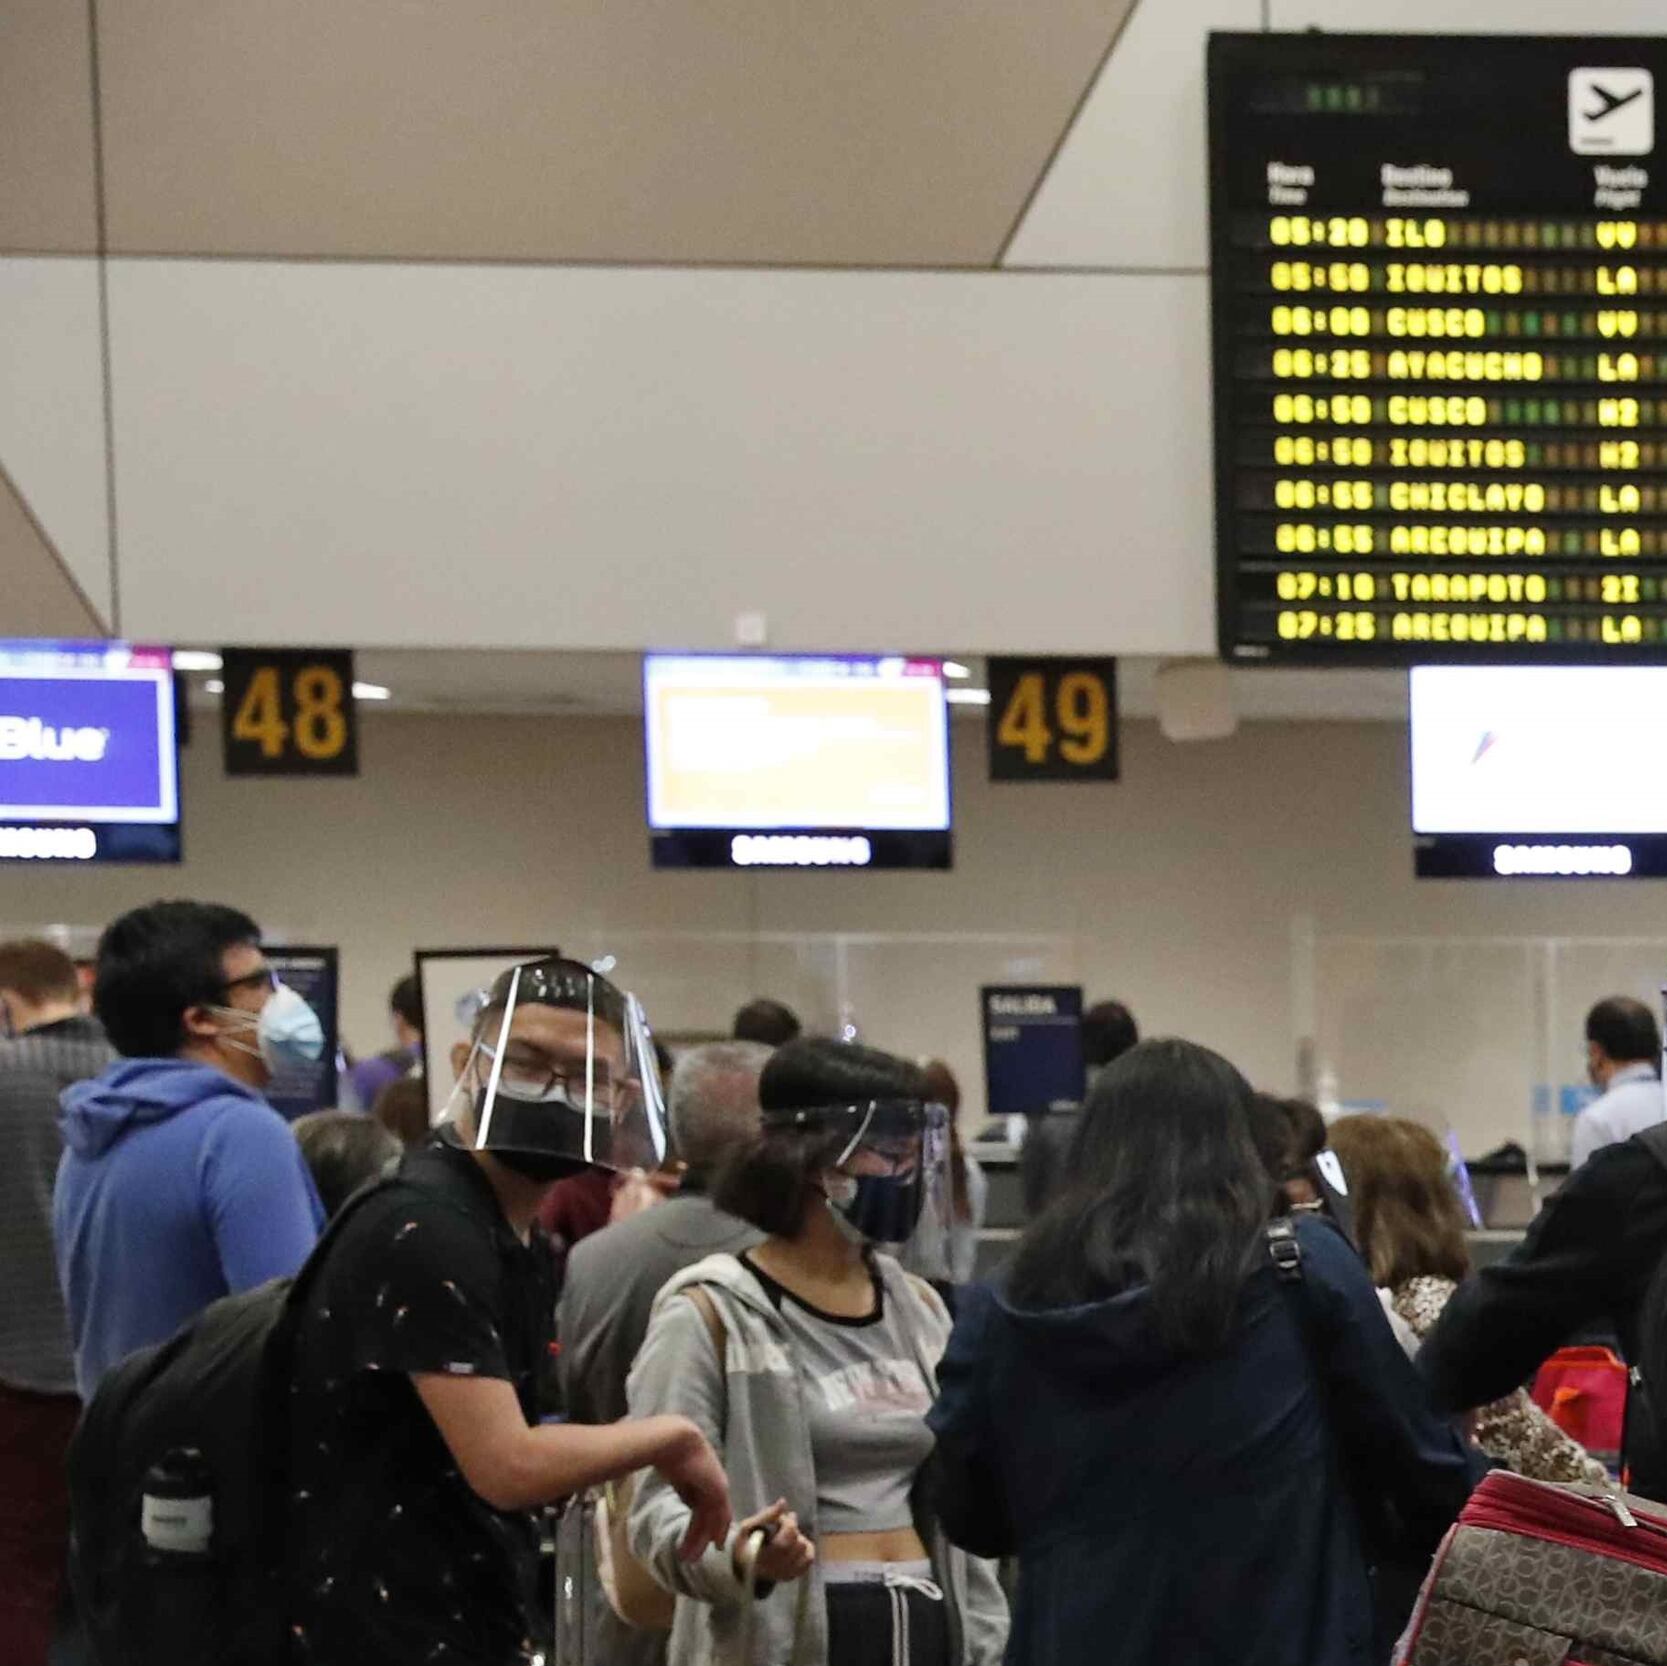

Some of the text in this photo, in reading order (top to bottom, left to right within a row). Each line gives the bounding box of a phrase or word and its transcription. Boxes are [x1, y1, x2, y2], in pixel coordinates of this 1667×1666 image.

[1270, 216, 1369, 247] 05:20
[1386, 218, 1446, 248] ILO
[1271, 262, 1370, 292] 05:50
[1596, 266, 1638, 295] LA
[1272, 306, 1371, 336] 06:00
[1386, 307, 1485, 338] CUSCO
[1273, 349, 1371, 379] 06:25
[1387, 350, 1543, 381] AYACUCHO
[1597, 353, 1639, 382] LA
[1273, 394, 1372, 424] 06:50
[1388, 395, 1487, 426] CUSCO
[1274, 437, 1372, 466] 06:50
[1275, 480, 1373, 510] 06:55
[1389, 482, 1545, 512] CHICLAYO
[1599, 484, 1640, 513] LA
[1276, 524, 1373, 554] 06:55
[1390, 526, 1546, 555] AREQUIPA
[1600, 528, 1641, 557] LA
[1277, 572, 1375, 601] 07:10
[1392, 573, 1546, 602] TARAPOTO
[1278, 611, 1375, 640] 07:25
[1392, 612, 1547, 642] AREQUIPA
[1601, 615, 1642, 644] LA
[234, 666, 348, 760] 48
[997, 672, 1110, 765] 49
[0, 716, 105, 761] Blue
